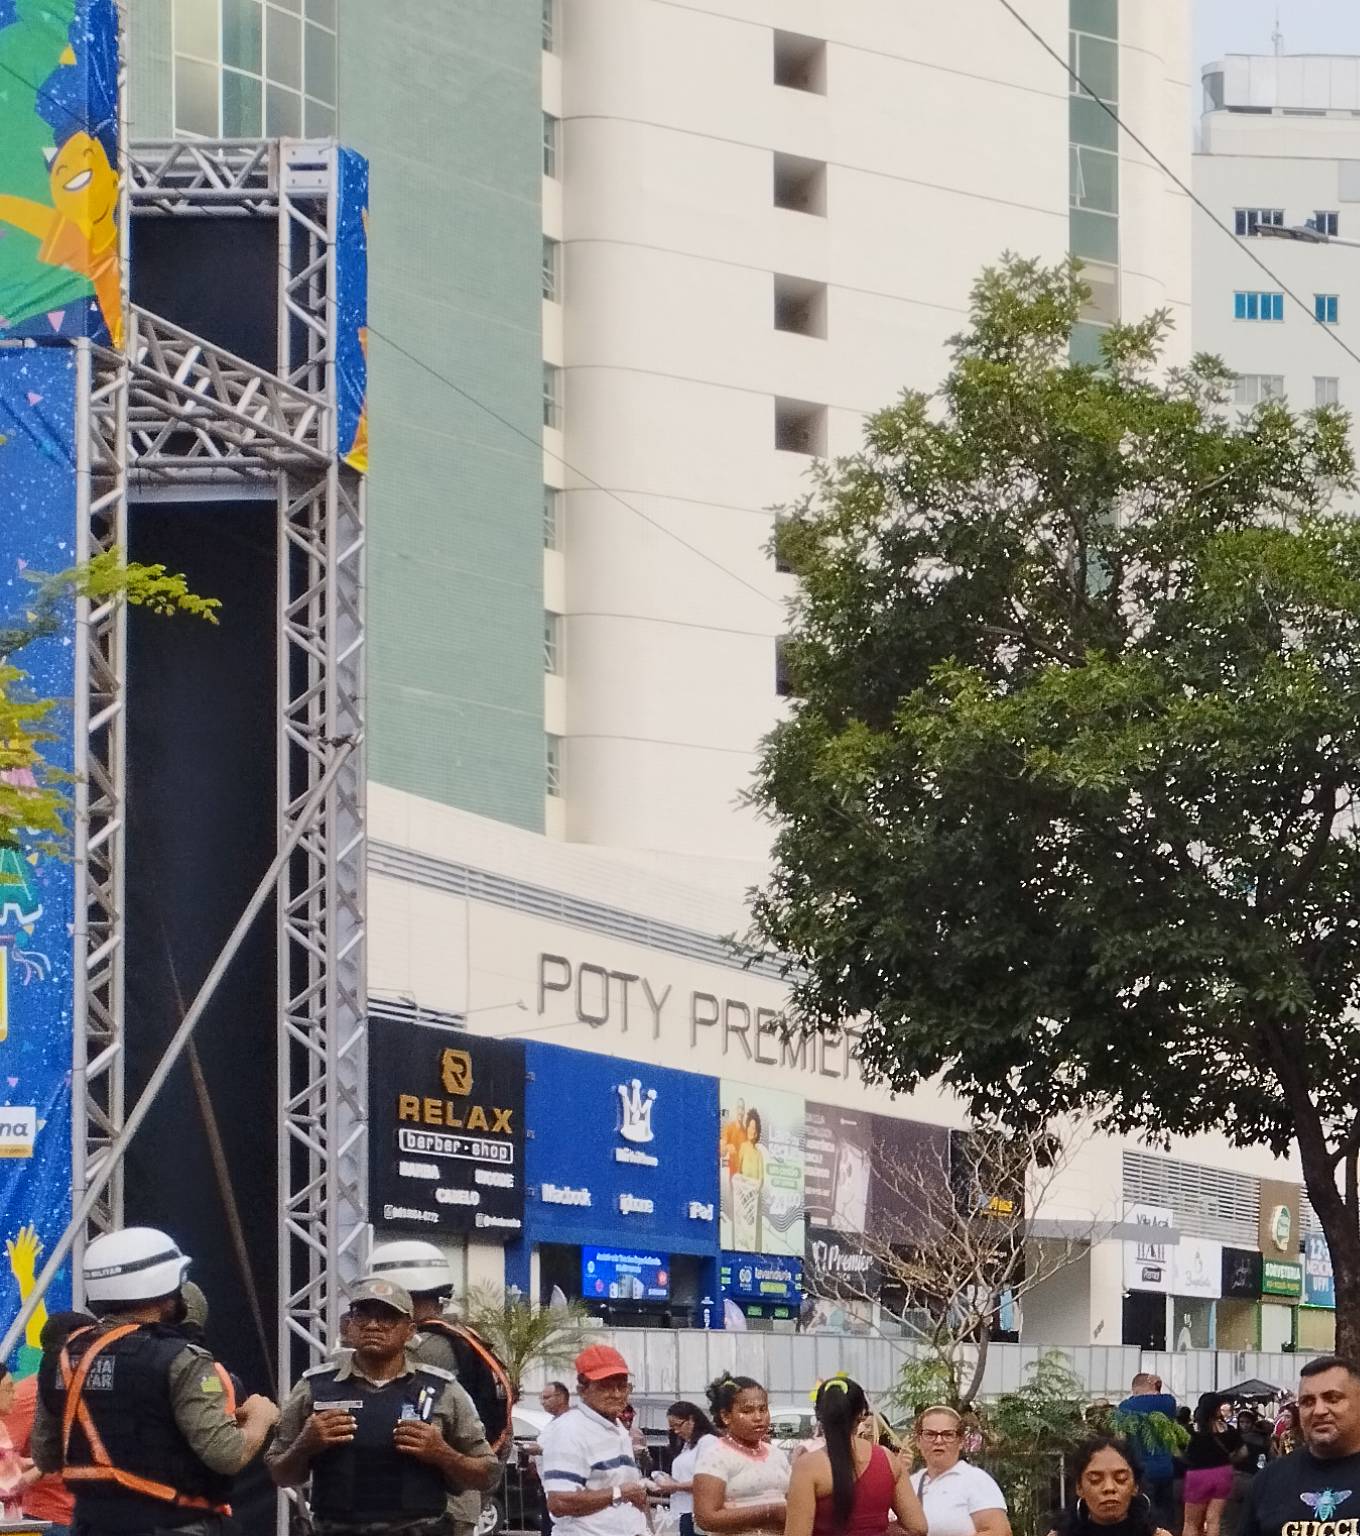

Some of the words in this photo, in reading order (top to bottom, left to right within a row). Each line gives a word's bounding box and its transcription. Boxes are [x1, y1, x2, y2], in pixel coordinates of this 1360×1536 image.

[537, 951, 672, 1040] POTY
[399, 1094, 513, 1134] RELAX
[406, 1132, 461, 1153] barber
[472, 1137, 508, 1161] shop
